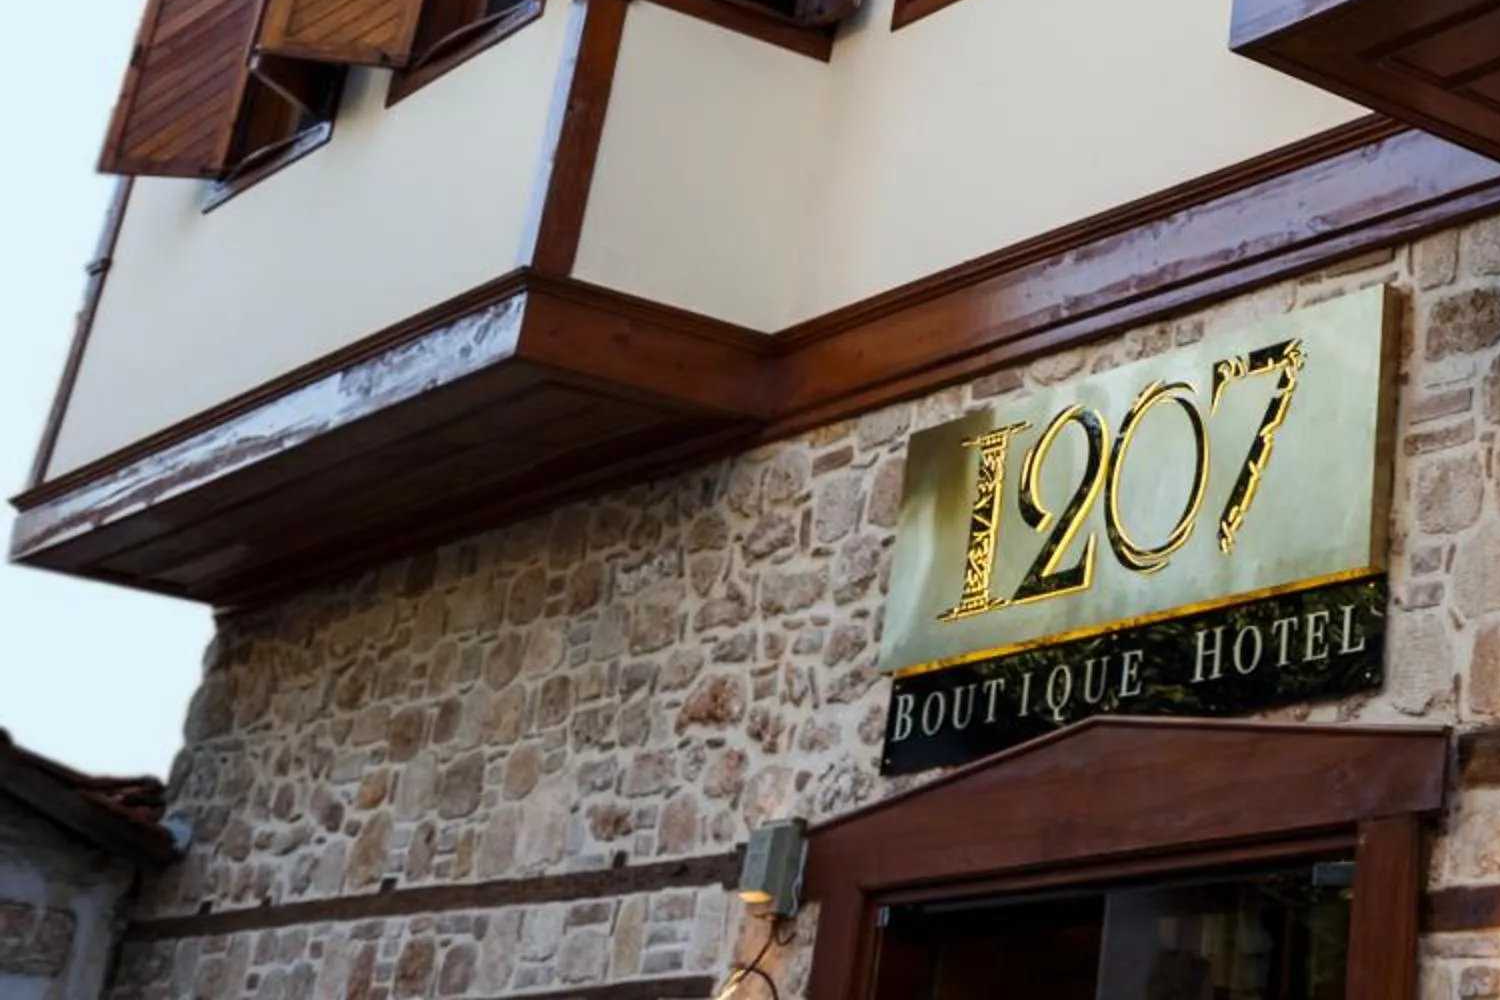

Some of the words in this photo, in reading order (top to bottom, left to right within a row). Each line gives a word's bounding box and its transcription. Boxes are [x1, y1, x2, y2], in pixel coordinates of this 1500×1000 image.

[938, 338, 1305, 621] 1207
[893, 651, 1144, 741] BOUTIQUE
[1191, 605, 1367, 684] HOTEL
